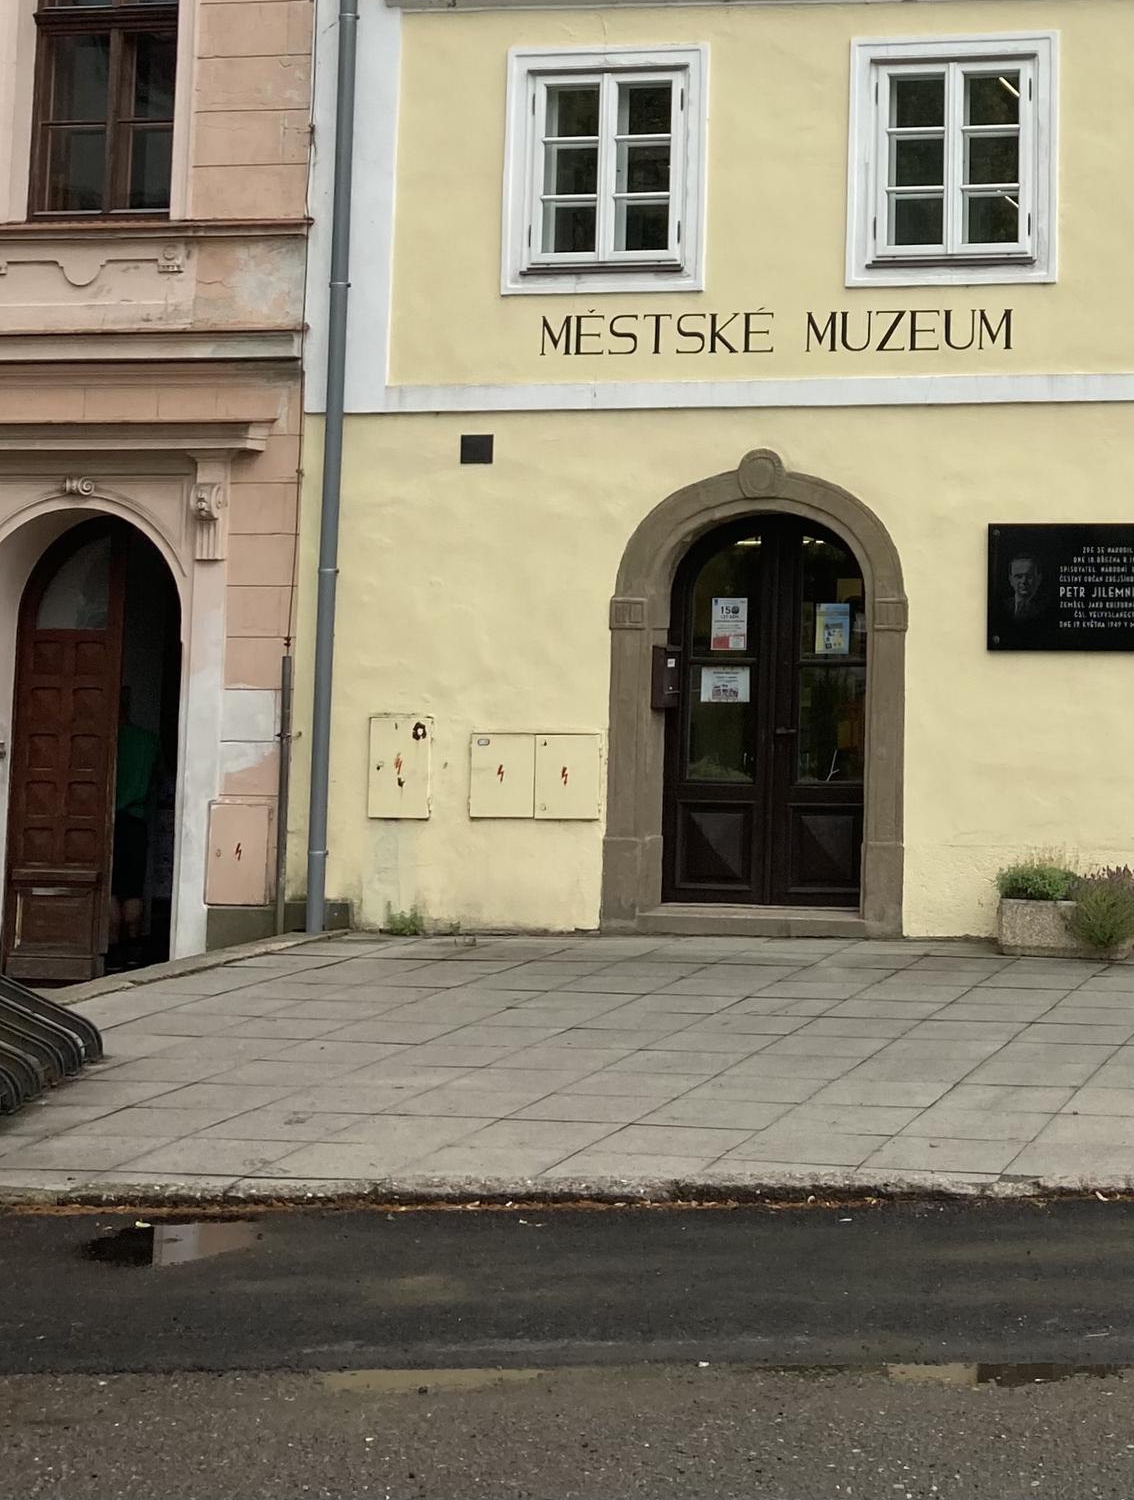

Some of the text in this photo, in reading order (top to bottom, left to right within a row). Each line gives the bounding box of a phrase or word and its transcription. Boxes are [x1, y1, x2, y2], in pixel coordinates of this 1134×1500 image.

[540, 307, 1014, 356] MĚSTSKÉ MUZEUM
[1060, 585, 1085, 598] PETR
